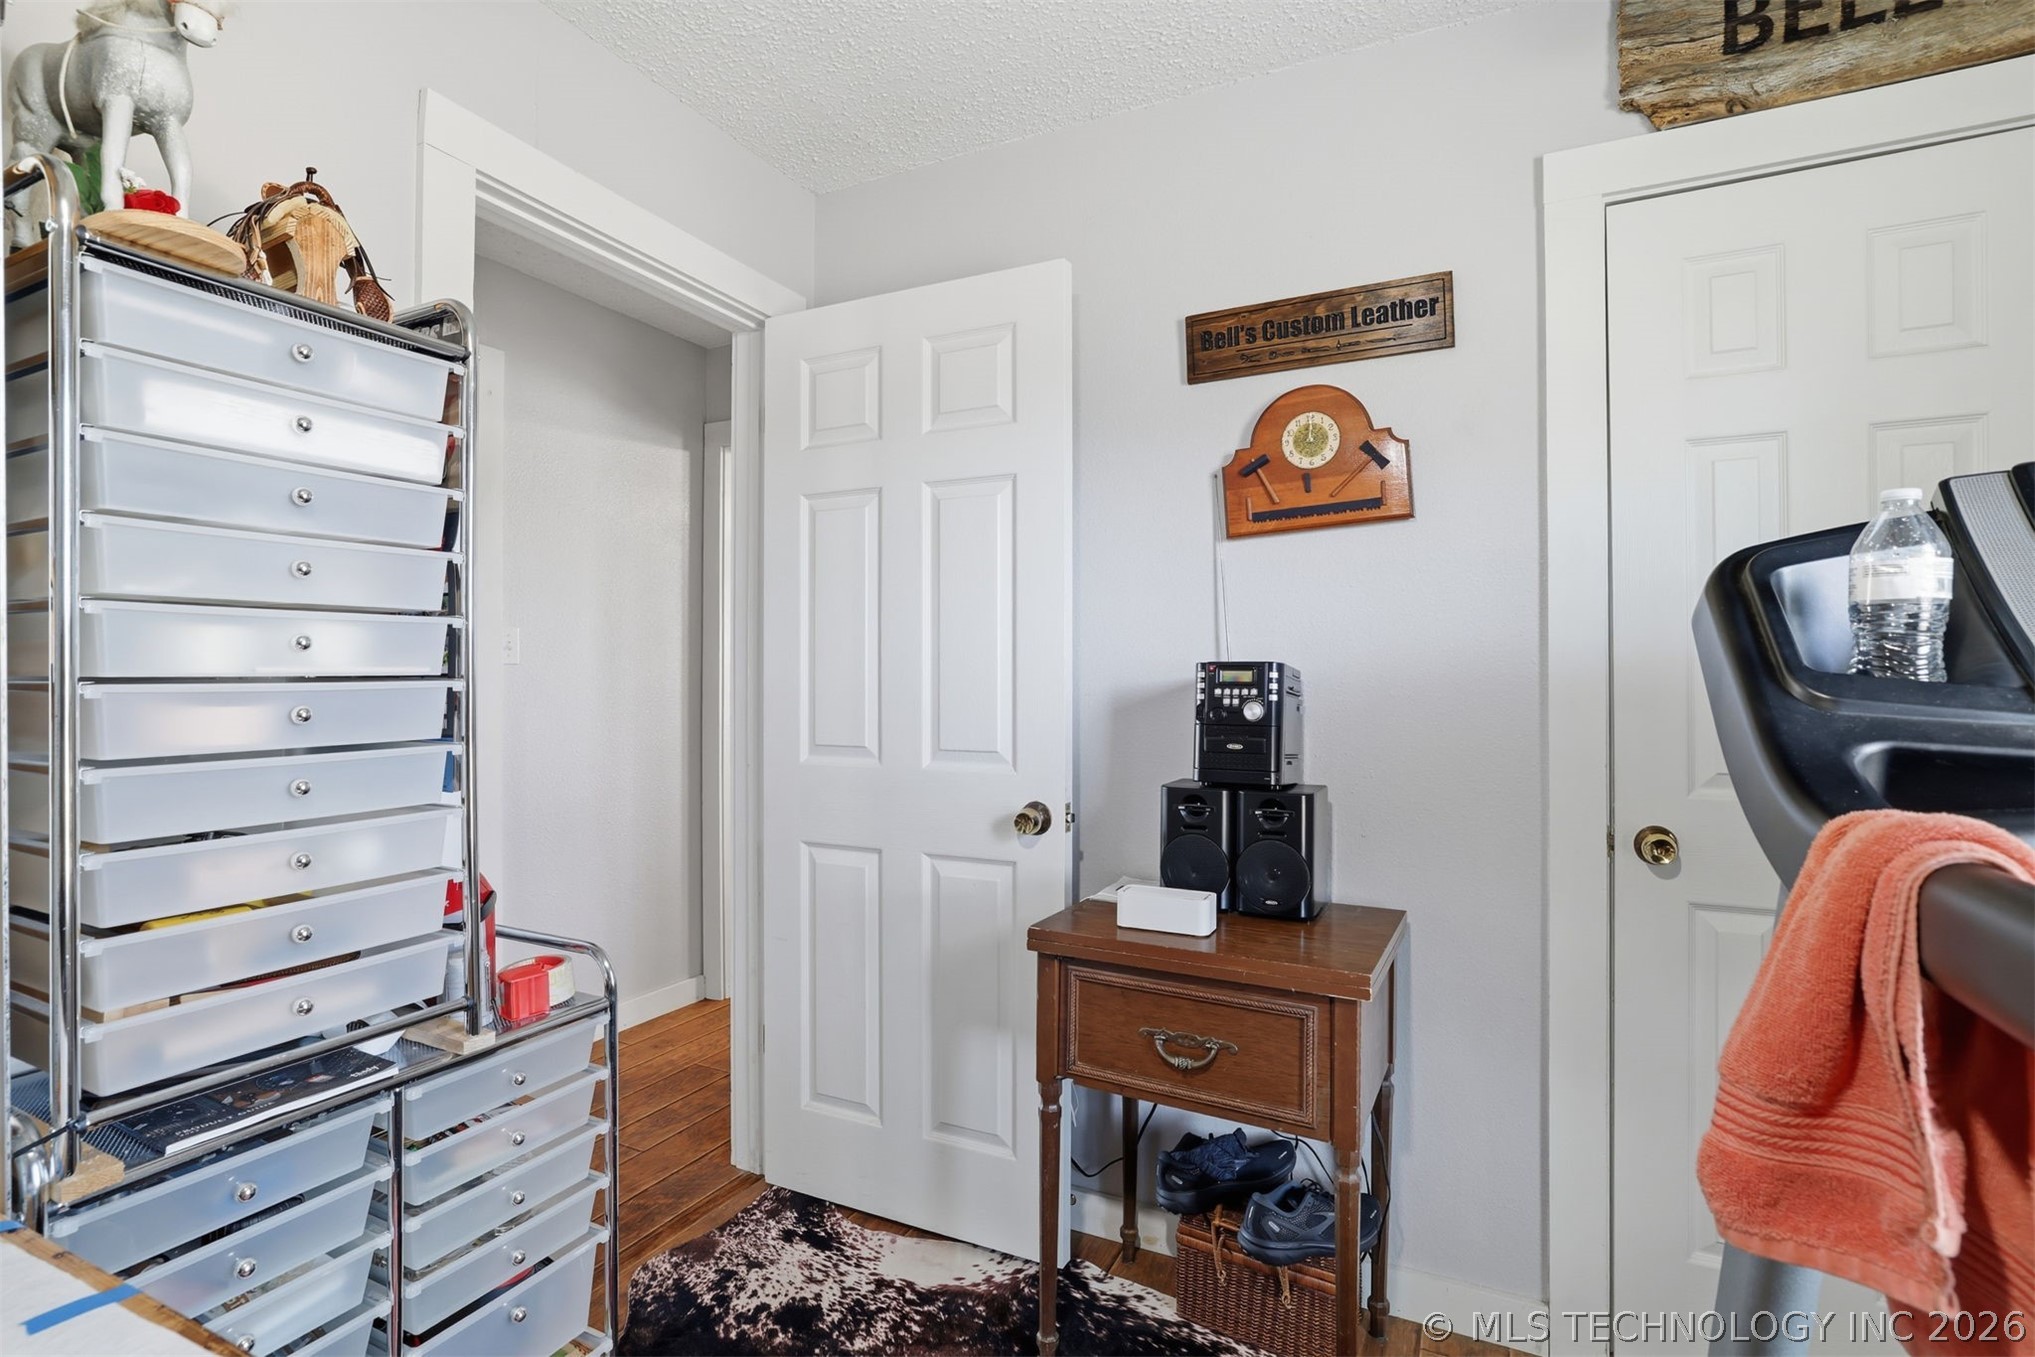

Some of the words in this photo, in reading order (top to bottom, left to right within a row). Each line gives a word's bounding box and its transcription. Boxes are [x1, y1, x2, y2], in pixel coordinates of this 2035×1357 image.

[1200, 324, 1257, 352] Bell's
[1262, 312, 1345, 342] Custom
[1350, 296, 1439, 328] Leather
